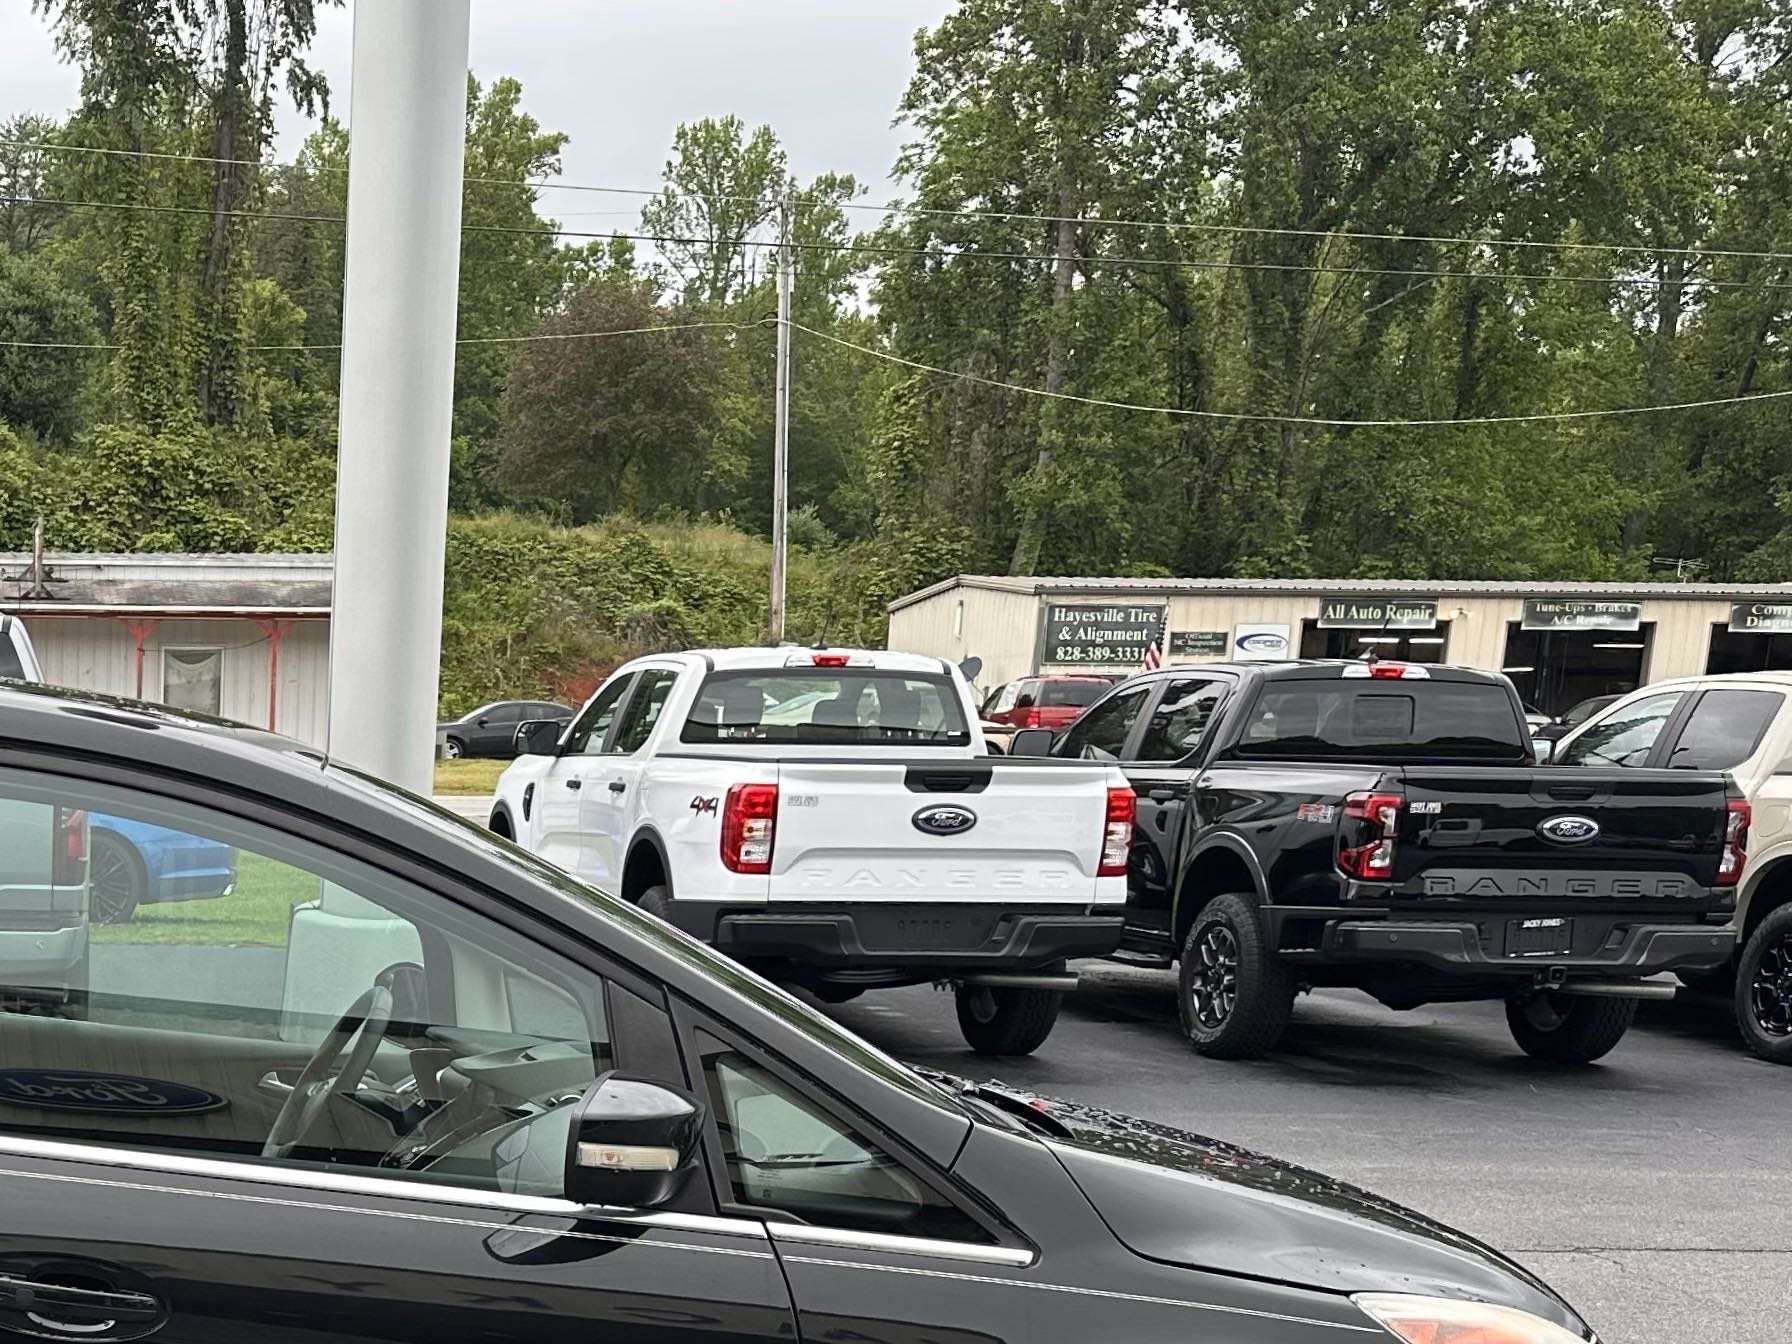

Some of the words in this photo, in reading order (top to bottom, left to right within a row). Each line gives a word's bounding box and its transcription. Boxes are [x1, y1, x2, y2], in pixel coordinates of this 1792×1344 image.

[1054, 608, 1124, 625] Hayesville
[1128, 608, 1157, 622] Tire
[1323, 604, 1345, 619] All
[1348, 605, 1382, 619] Auto
[1385, 604, 1432, 624] Repair
[1550, 614, 1573, 625] A/C
[1058, 627, 1072, 640] &
[1075, 627, 1147, 644] Alignment
[1056, 647, 1145, 661] 828-389-3331
[1425, 876, 1686, 898] RANGER
